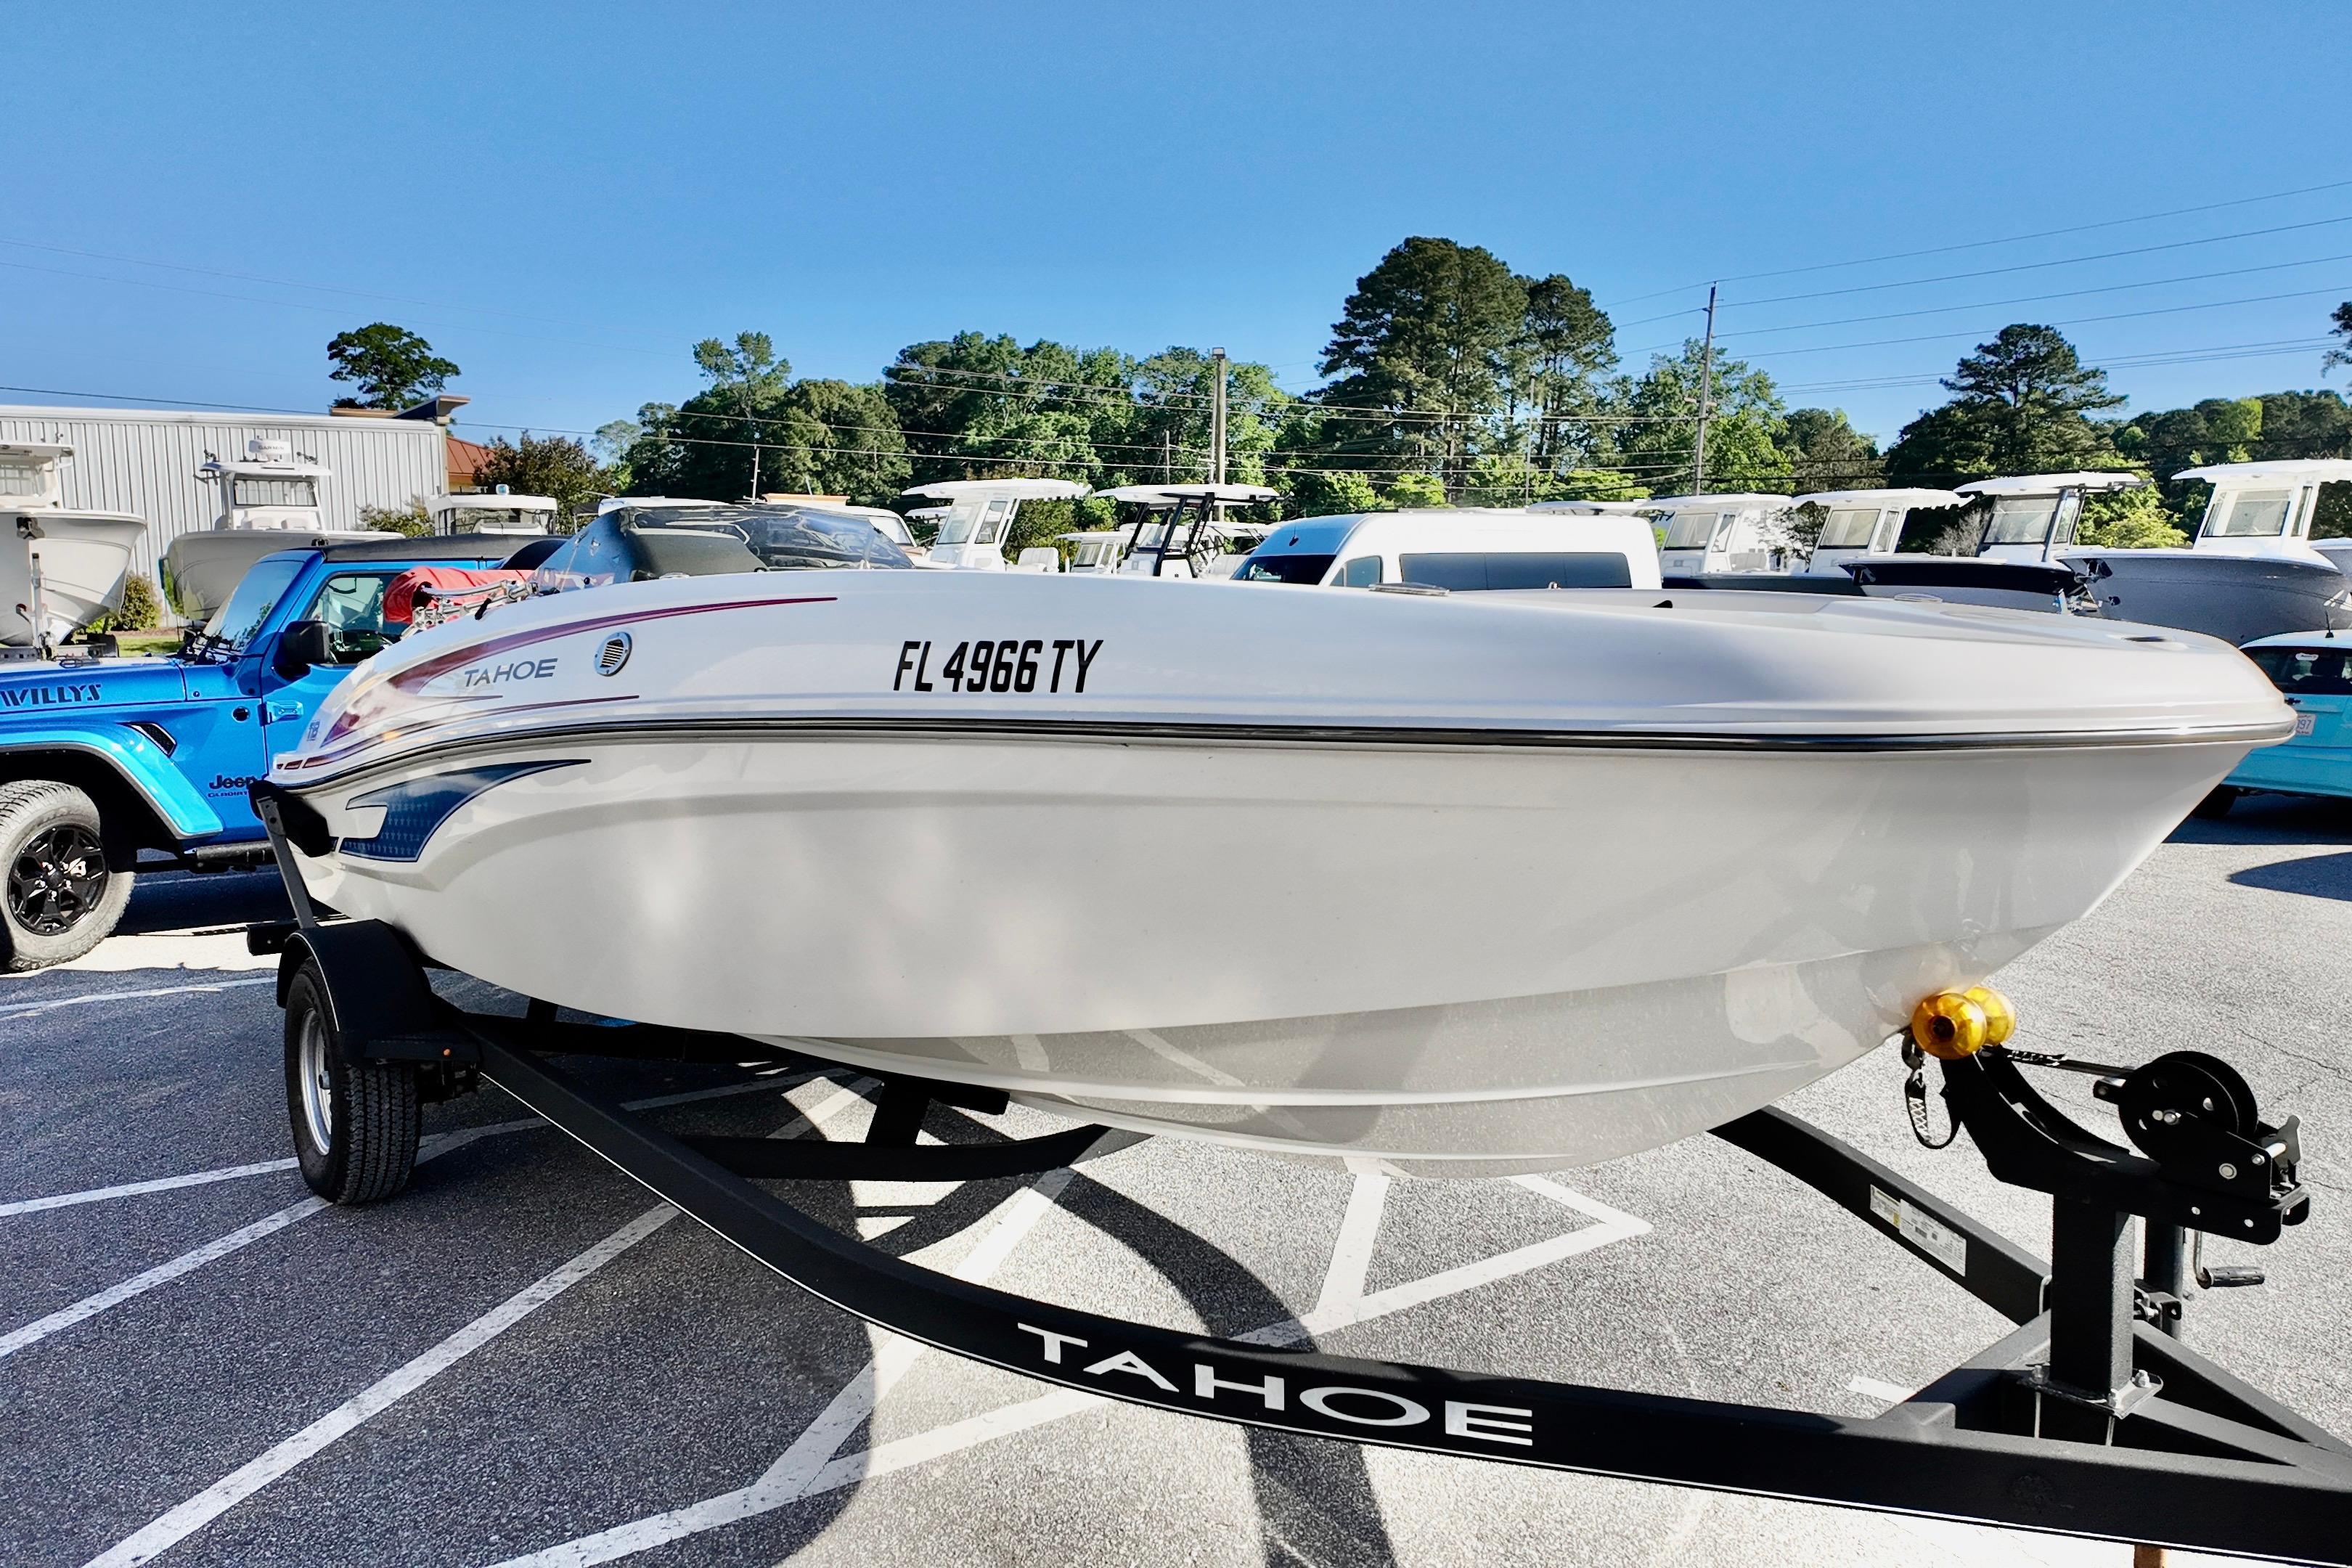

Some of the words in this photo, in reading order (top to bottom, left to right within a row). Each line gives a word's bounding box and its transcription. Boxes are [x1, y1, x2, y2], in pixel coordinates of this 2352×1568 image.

[464, 658, 558, 687] TAHOE
[893, 640, 933, 692] FL
[942, 640, 1043, 693] 4966
[1050, 640, 1104, 693] TY
[0, 684, 102, 706] WILLYS
[208, 775, 258, 790] Jeep
[1017, 1322, 1533, 1447] TAHOE
